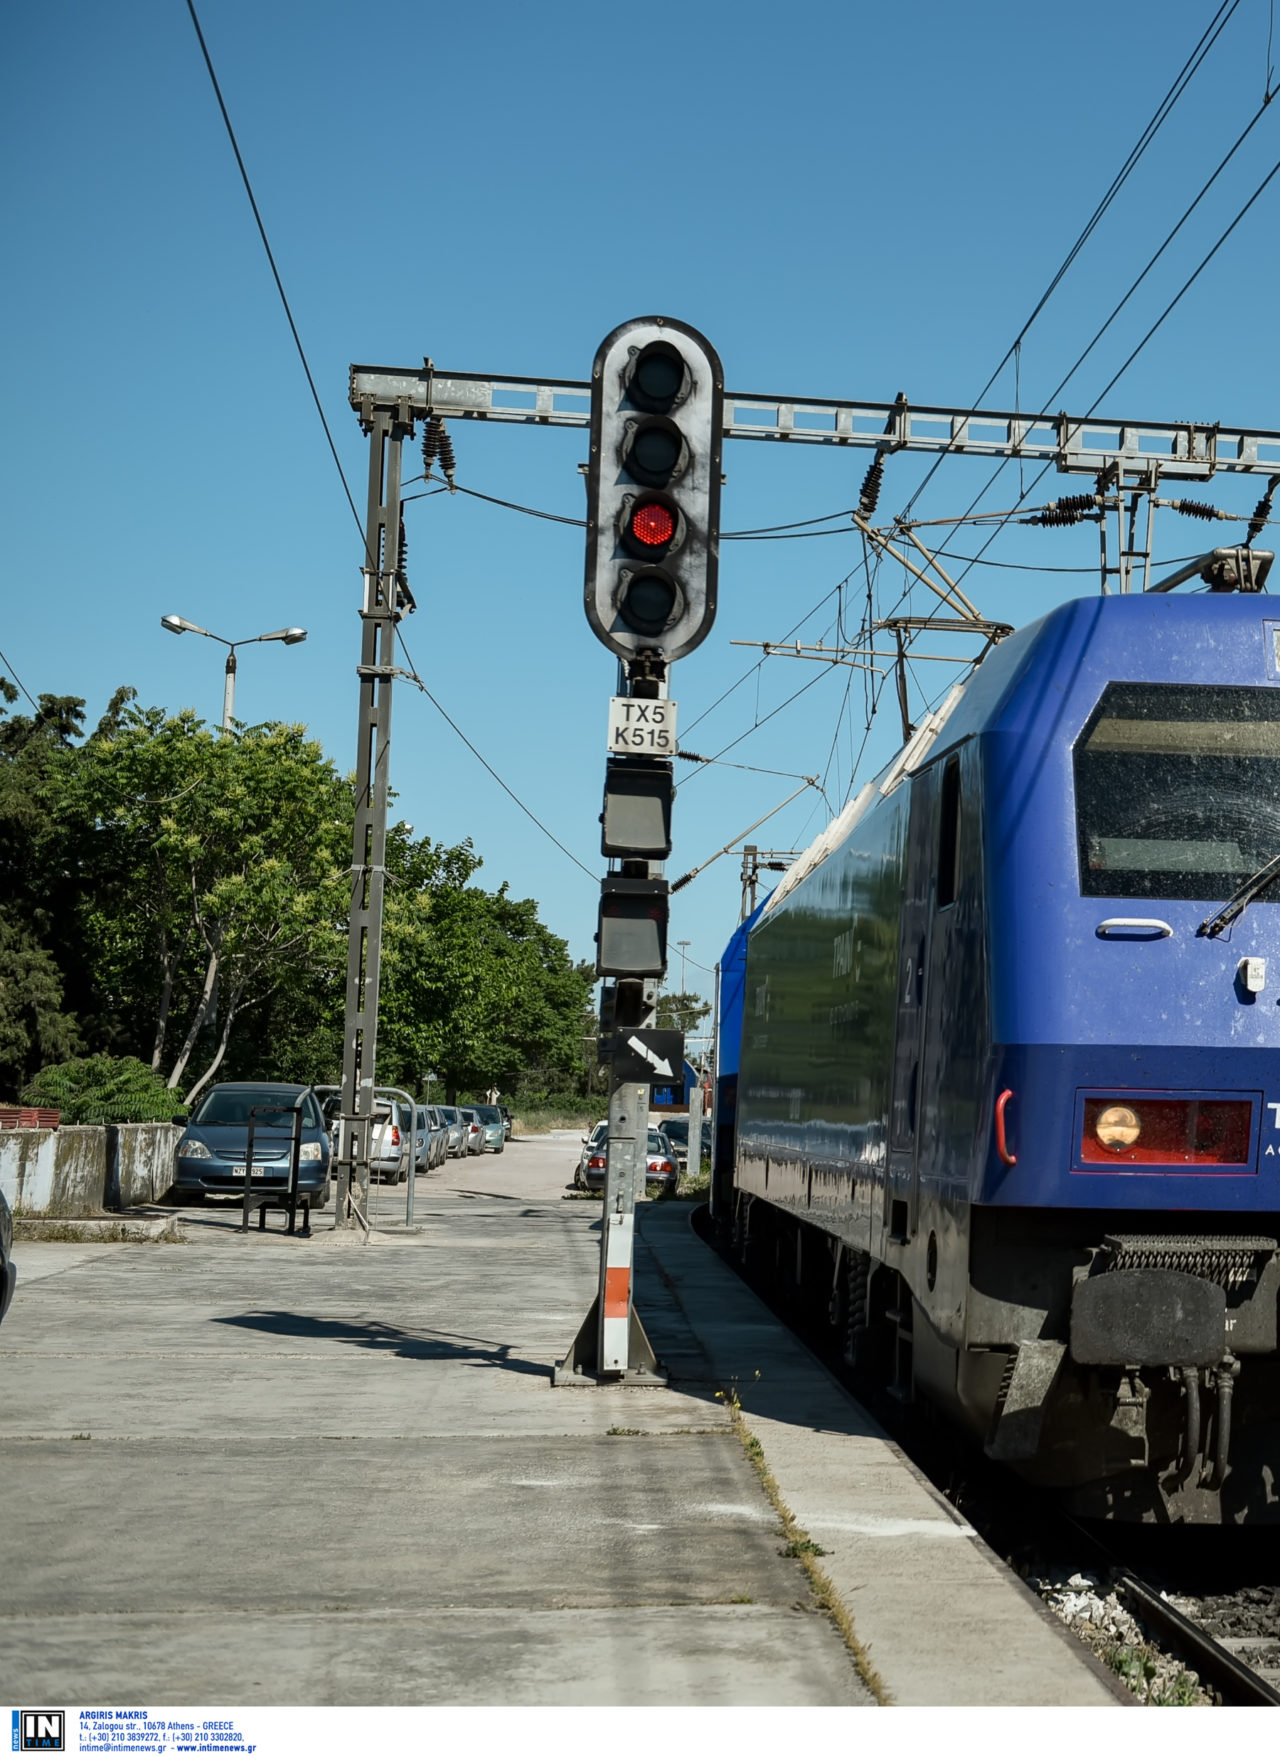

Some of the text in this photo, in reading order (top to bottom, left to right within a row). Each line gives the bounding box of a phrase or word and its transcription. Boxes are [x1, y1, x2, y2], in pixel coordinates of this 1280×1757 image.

[621, 703, 665, 724] TX5
[614, 726, 670, 748] K515
[1265, 1144, 1275, 1156] A
